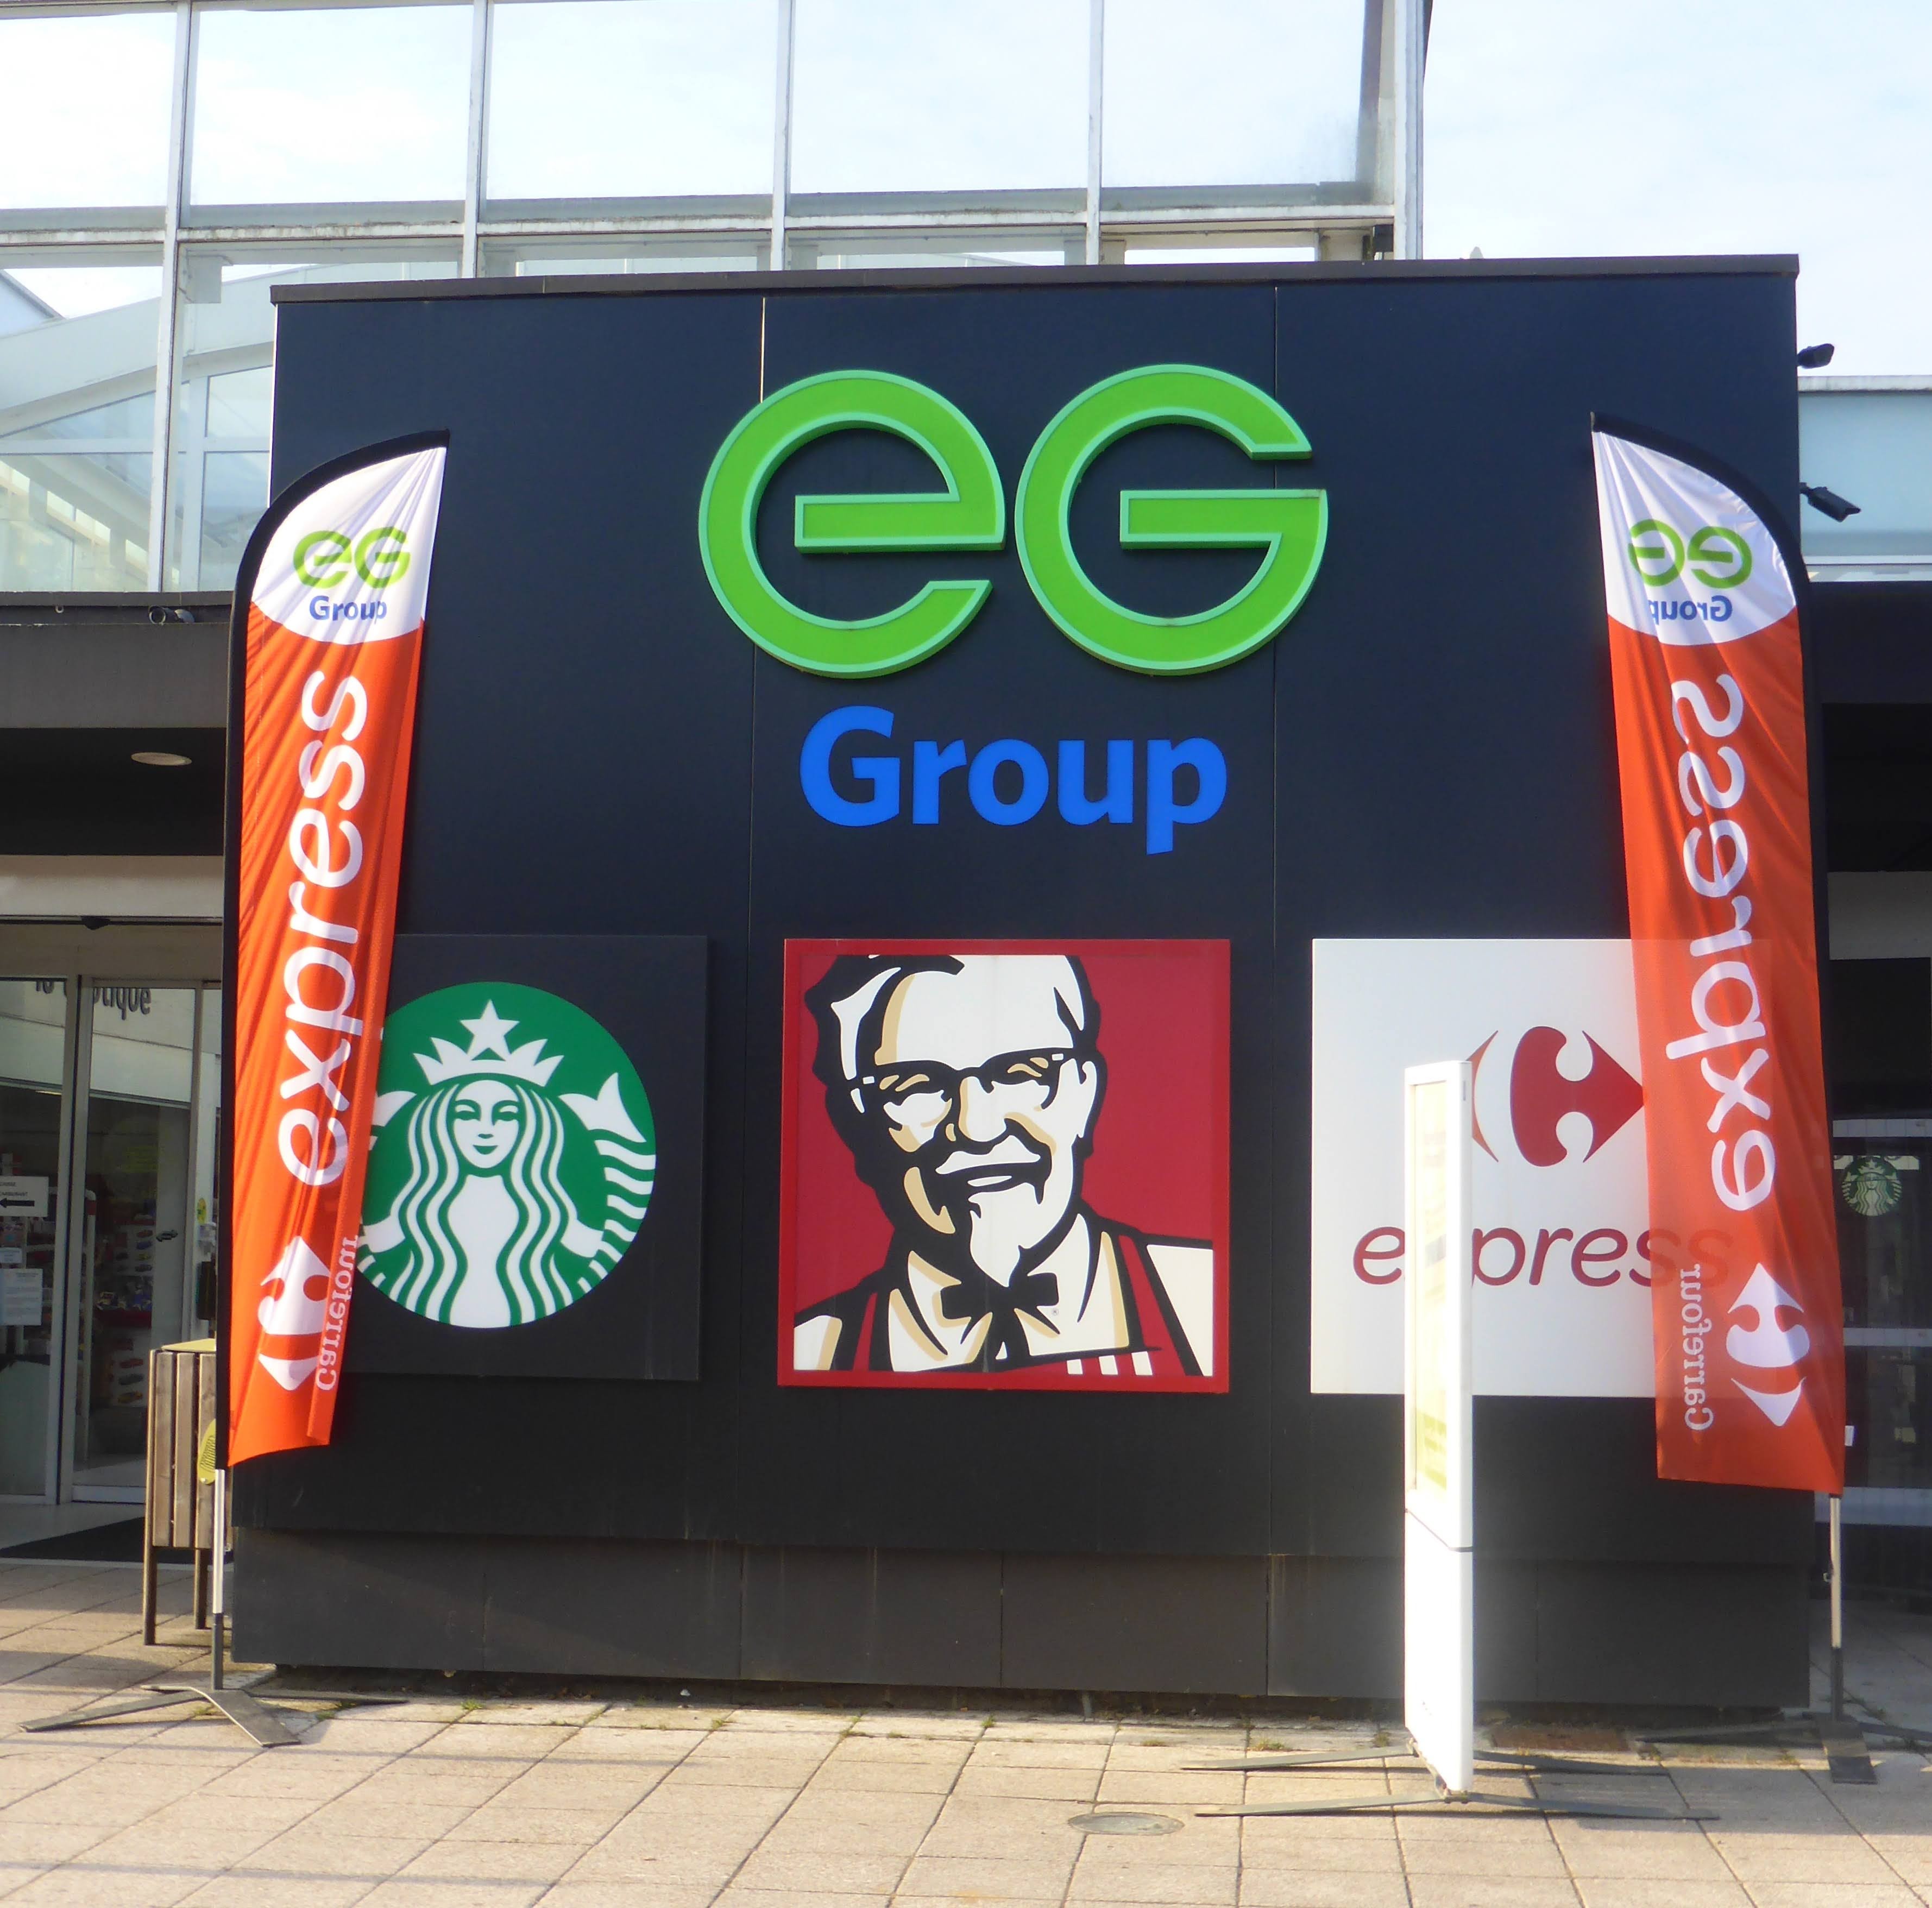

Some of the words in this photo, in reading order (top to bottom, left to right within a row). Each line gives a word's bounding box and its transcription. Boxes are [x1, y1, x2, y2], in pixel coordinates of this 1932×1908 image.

[309, 595, 387, 624] Group
[799, 705, 1227, 855] Group
[277, 670, 367, 1187] express
[1352, 1226, 1734, 1287] epress
